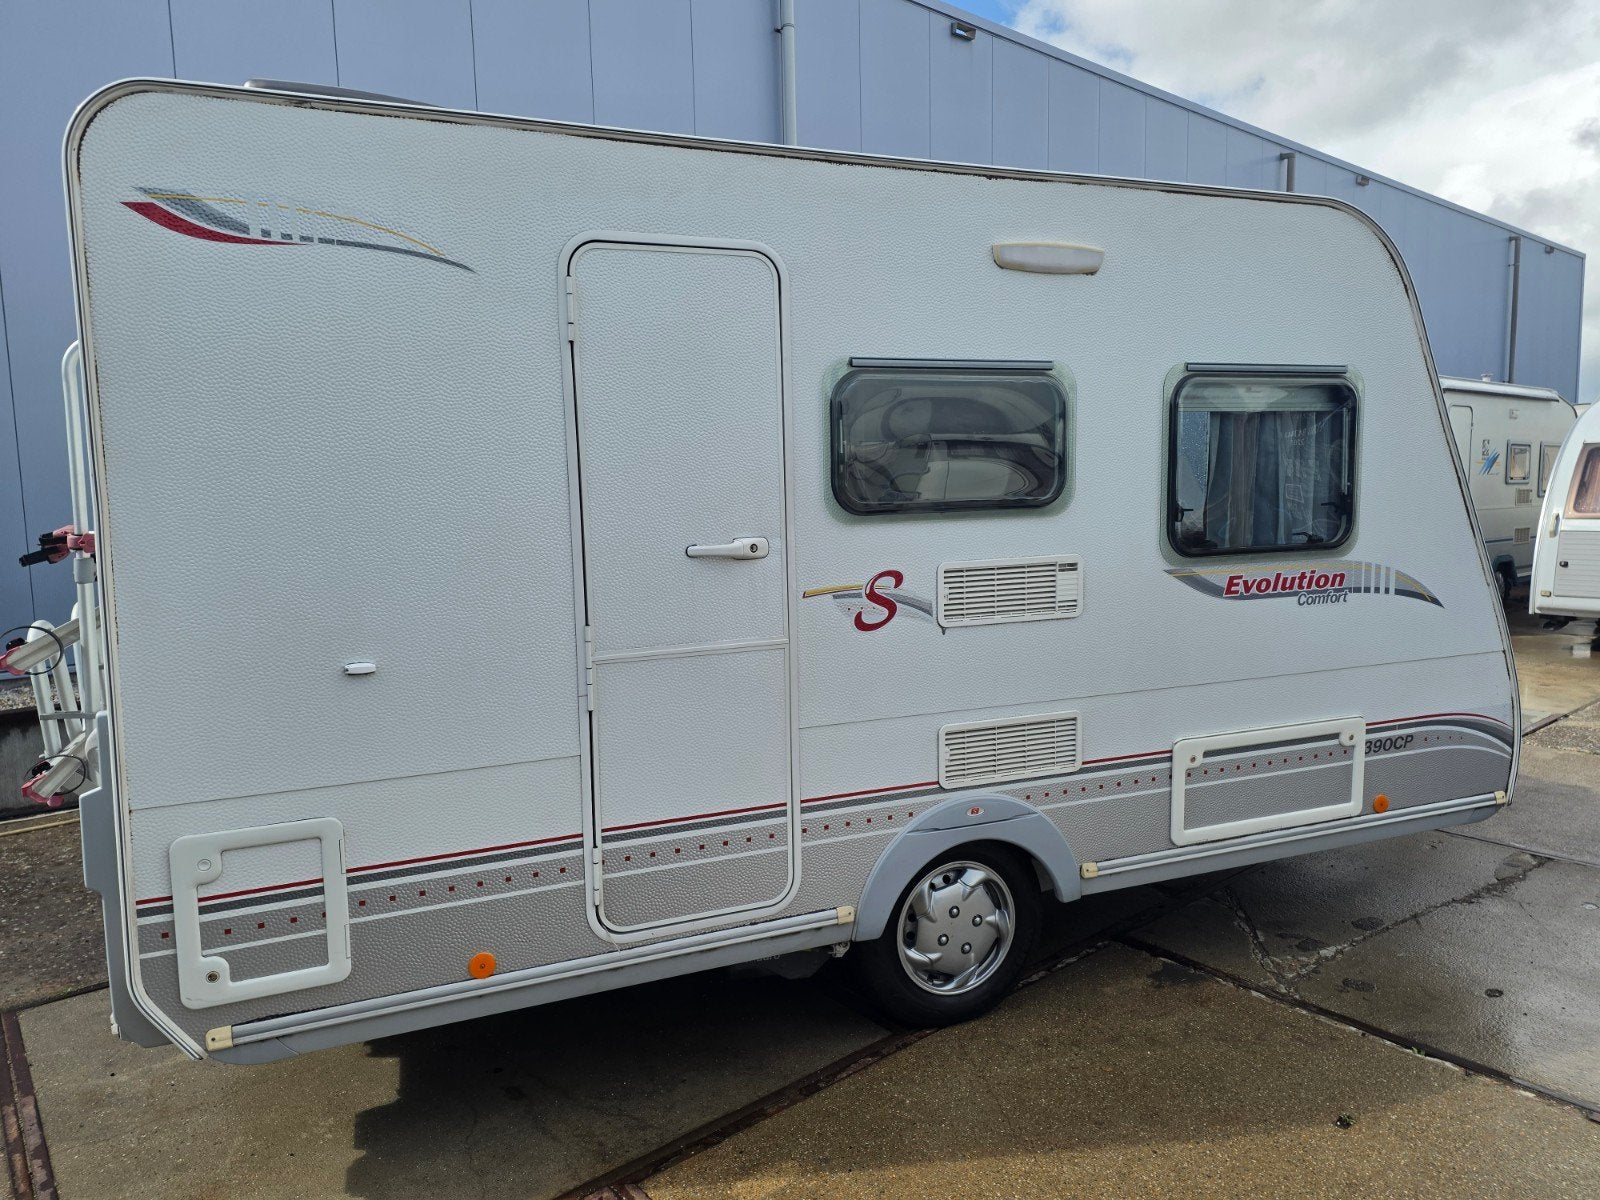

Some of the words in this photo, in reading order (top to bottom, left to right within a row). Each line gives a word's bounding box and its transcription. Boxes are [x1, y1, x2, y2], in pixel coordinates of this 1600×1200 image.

[1223, 570, 1346, 596] Evolution
[854, 570, 904, 632] S
[1298, 590, 1348, 606] Comfort
[1365, 735, 1414, 755] 390CP
